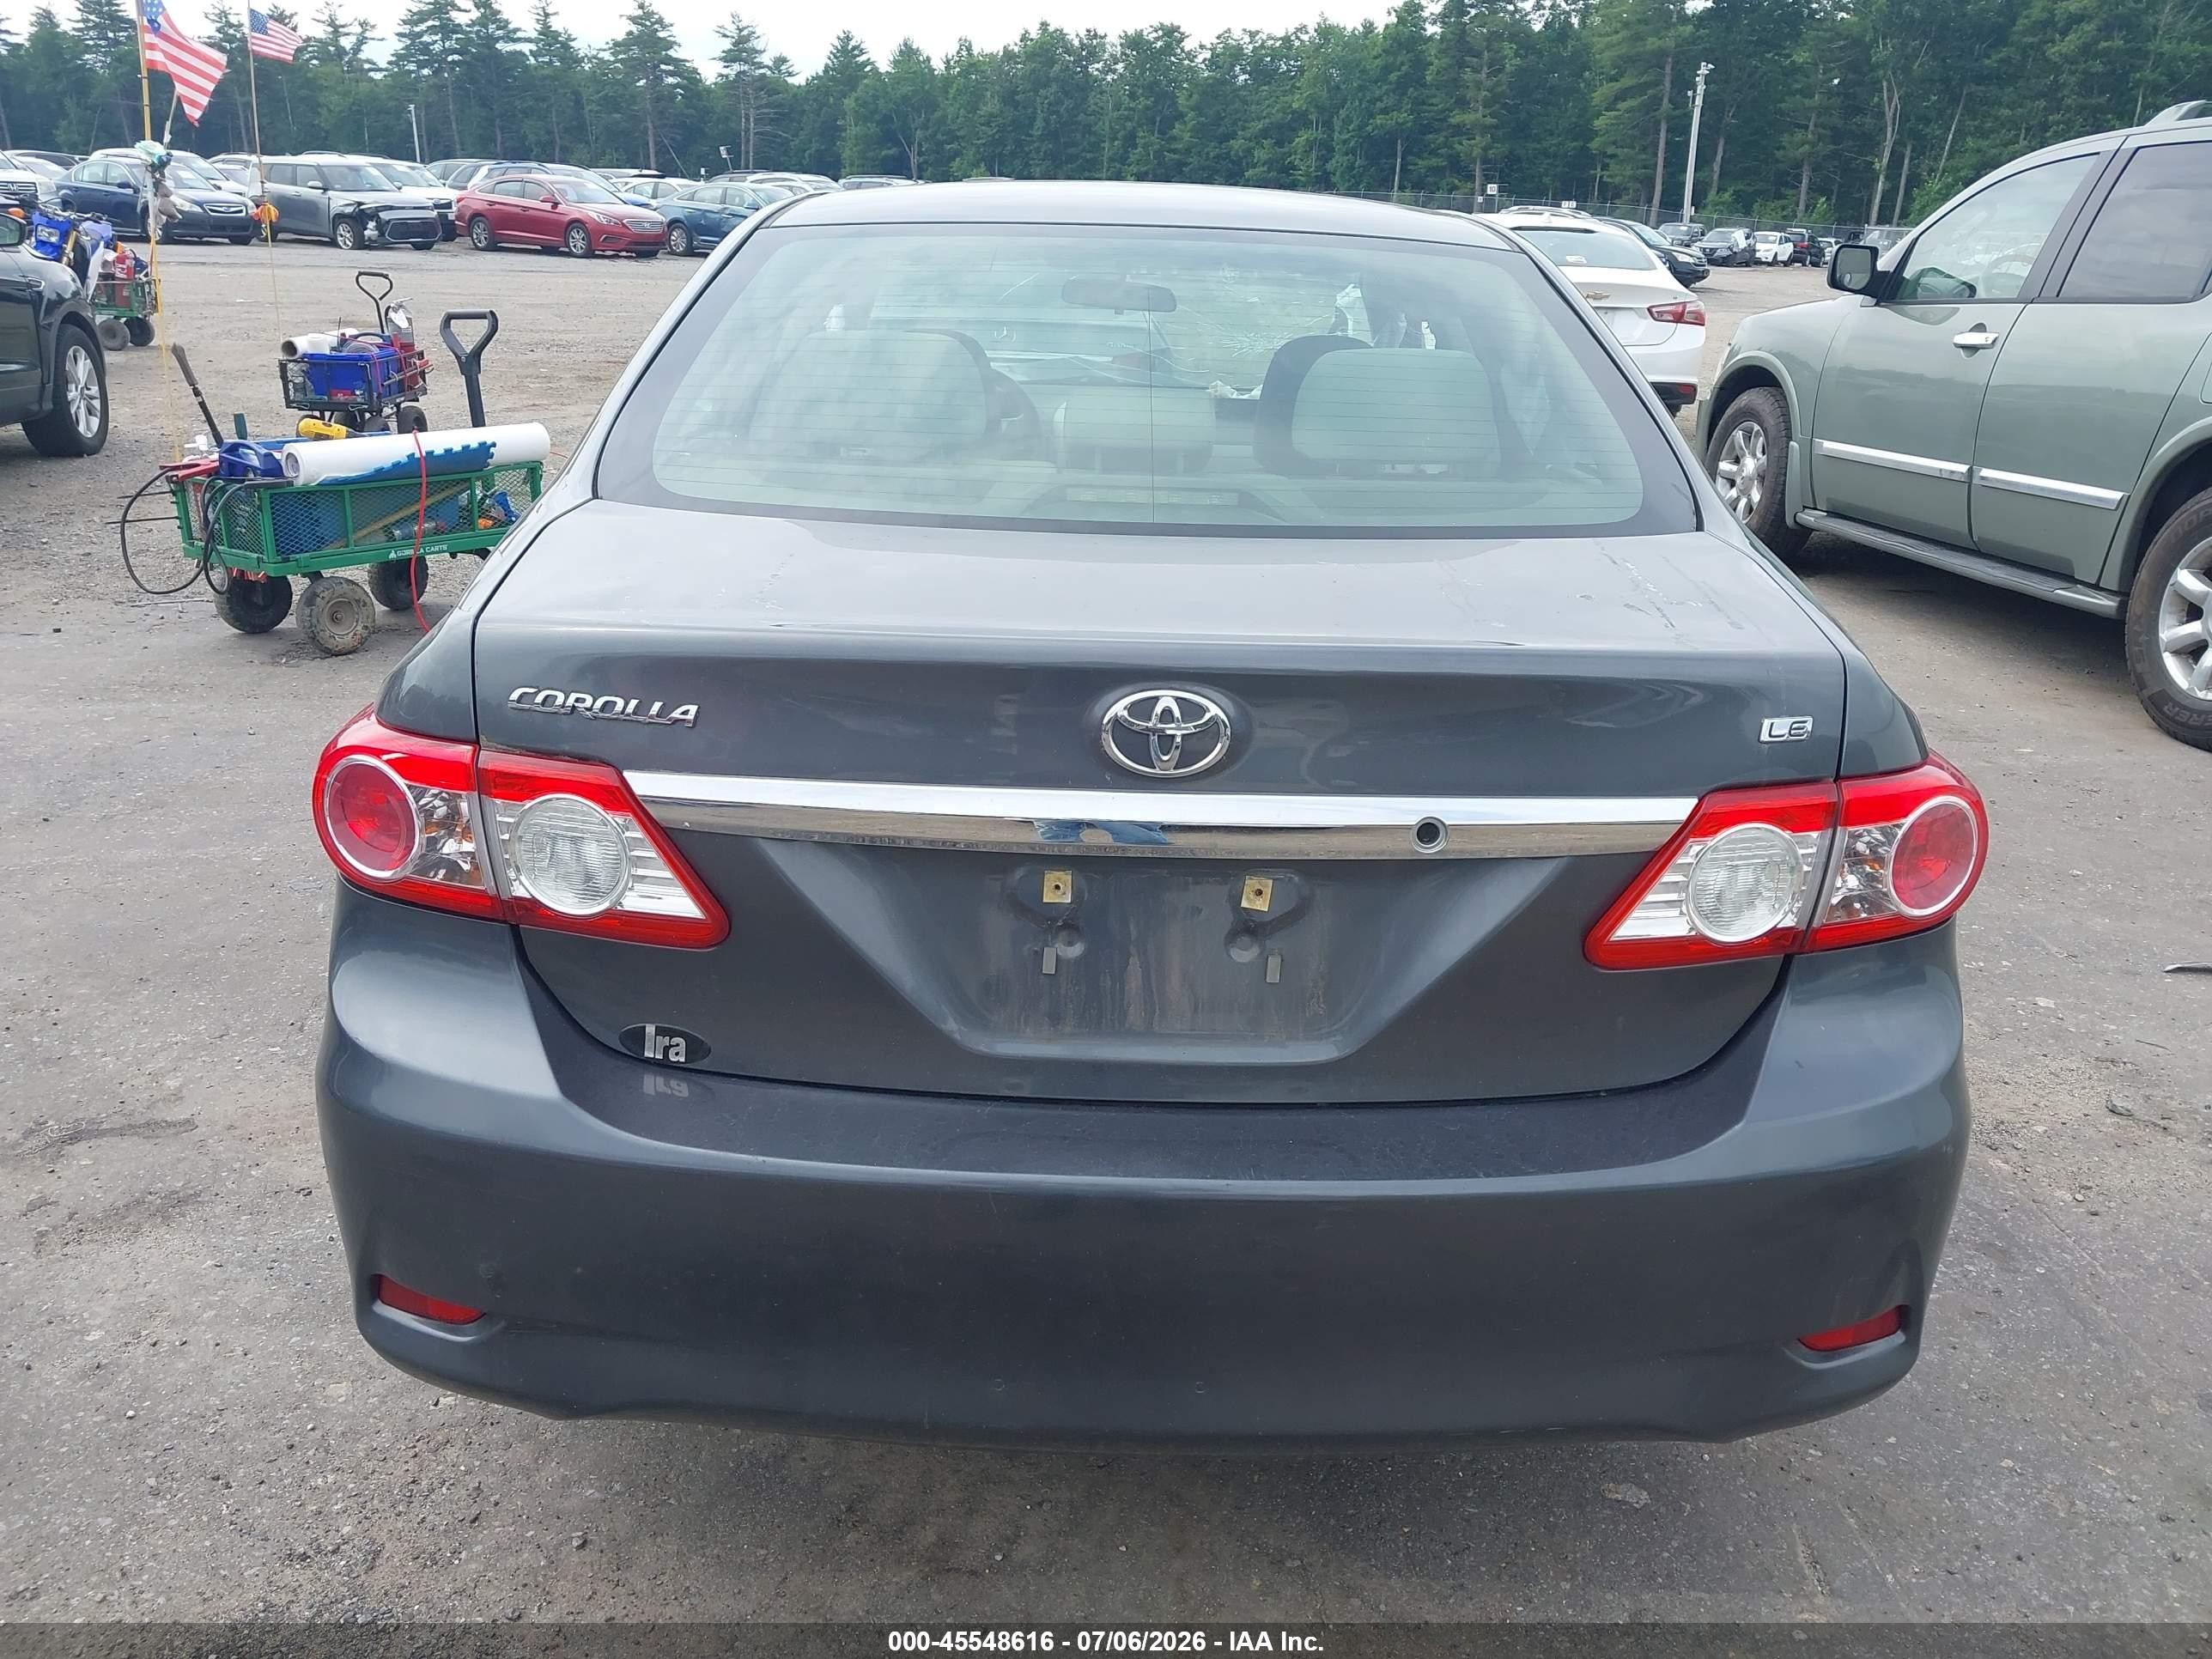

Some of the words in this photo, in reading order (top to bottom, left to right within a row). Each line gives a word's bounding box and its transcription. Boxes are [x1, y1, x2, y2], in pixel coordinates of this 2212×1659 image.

[397, 546, 425, 556] GORIA
[425, 544, 448, 553] CARTS
[507, 686, 700, 728] COROLLA
[1759, 716, 1813, 743] LE
[644, 1023, 686, 1062] Ira
